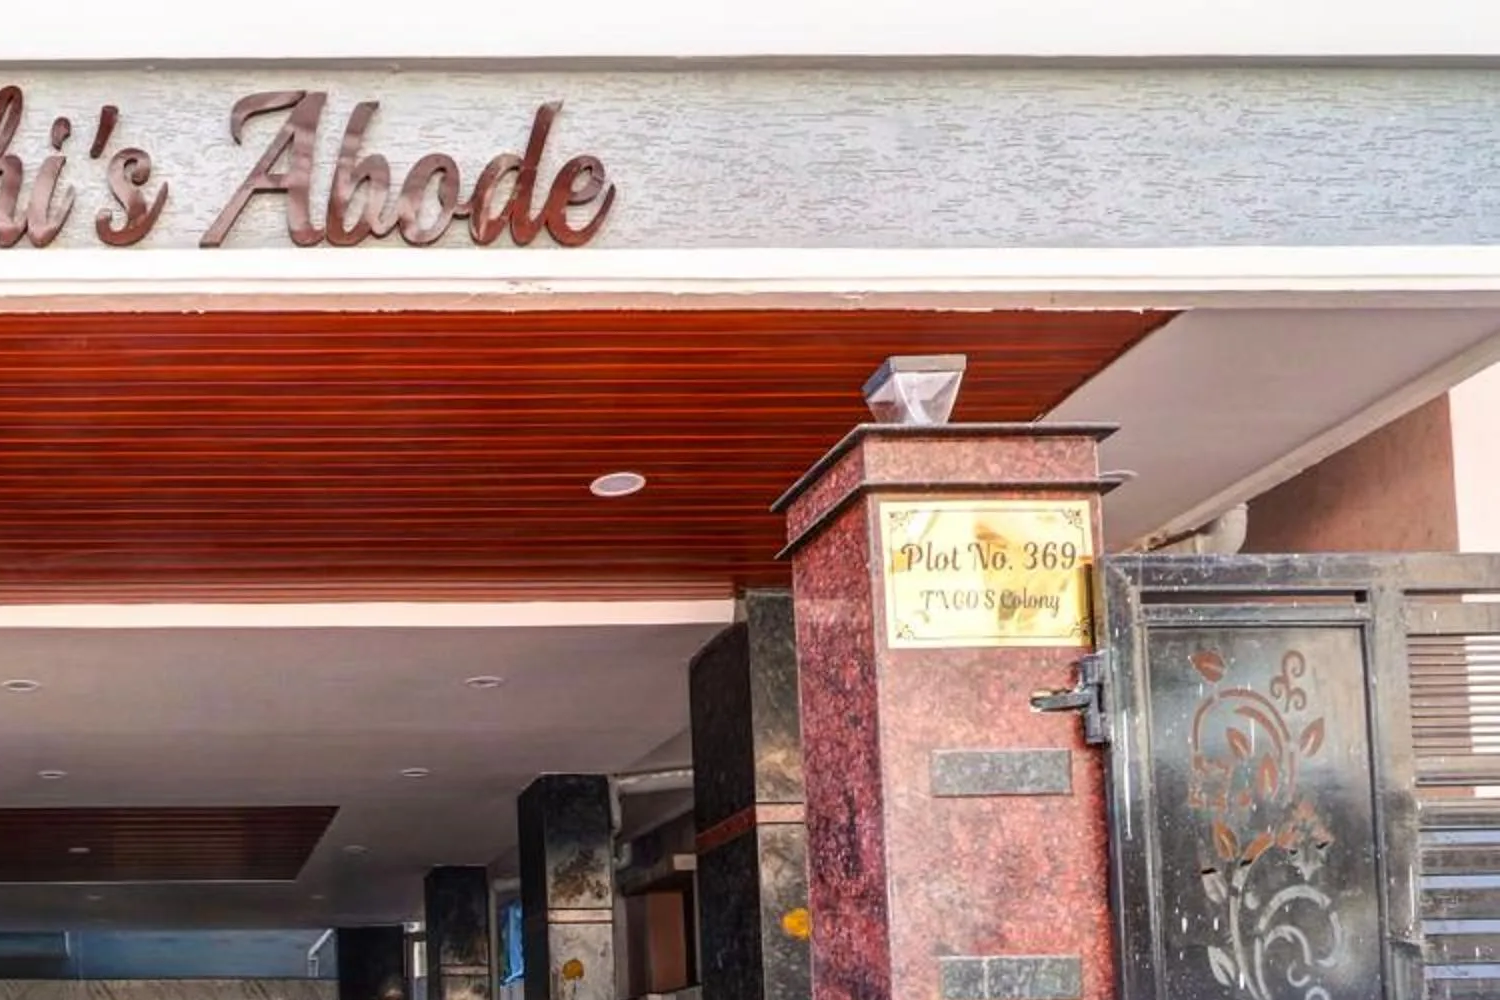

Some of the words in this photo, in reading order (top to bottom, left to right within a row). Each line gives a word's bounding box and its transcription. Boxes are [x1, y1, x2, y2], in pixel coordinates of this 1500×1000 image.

[198, 89, 617, 249] Abode
[901, 542, 963, 571] Plot
[967, 542, 1013, 571] No.
[1024, 541, 1077, 570] 369
